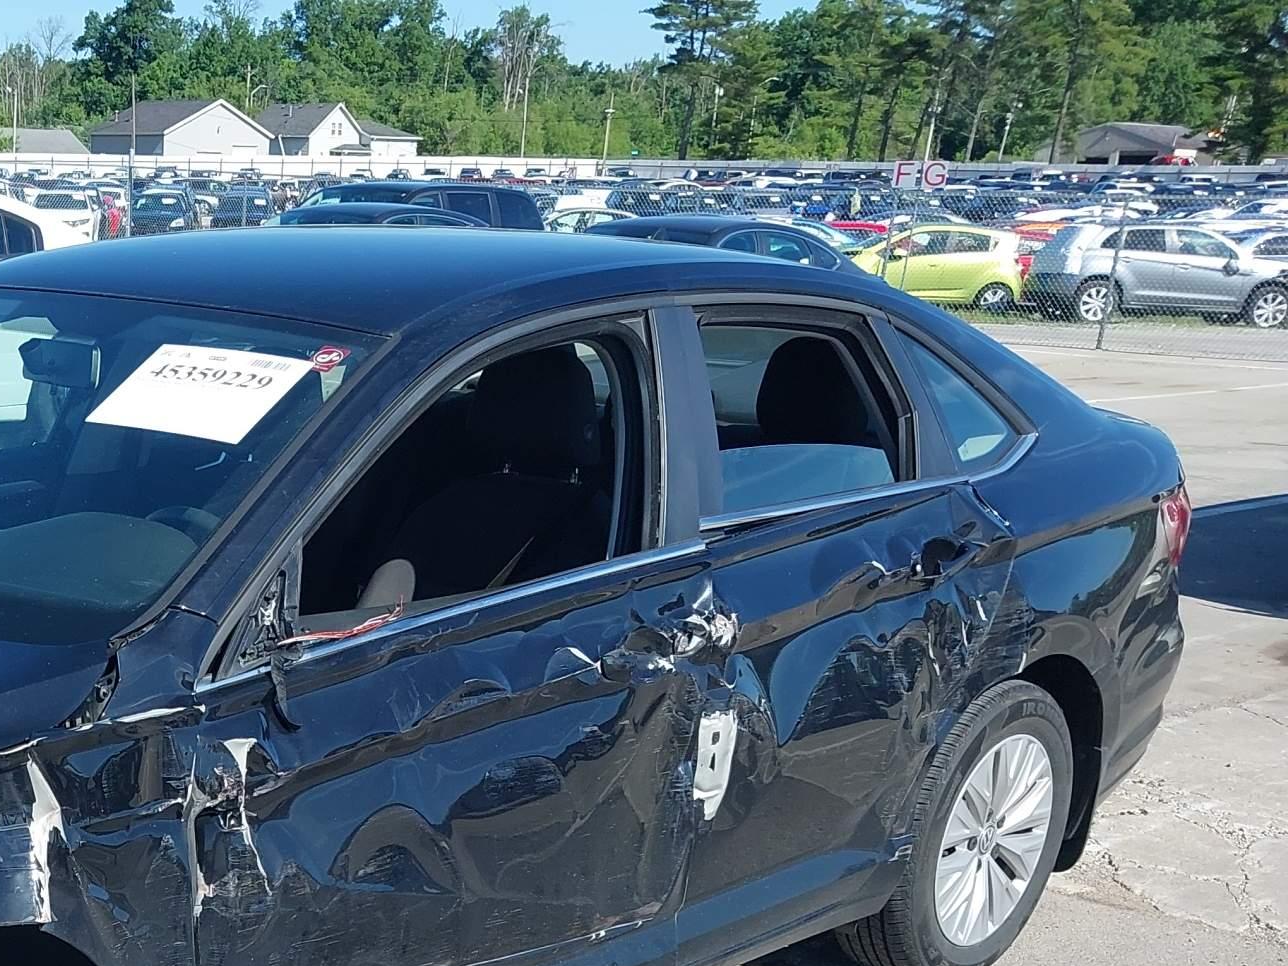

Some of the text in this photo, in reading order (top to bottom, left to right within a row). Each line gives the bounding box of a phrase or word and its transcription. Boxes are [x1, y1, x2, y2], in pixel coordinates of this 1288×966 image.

[895, 162, 946, 186] F G
[150, 363, 273, 390] 45359229
